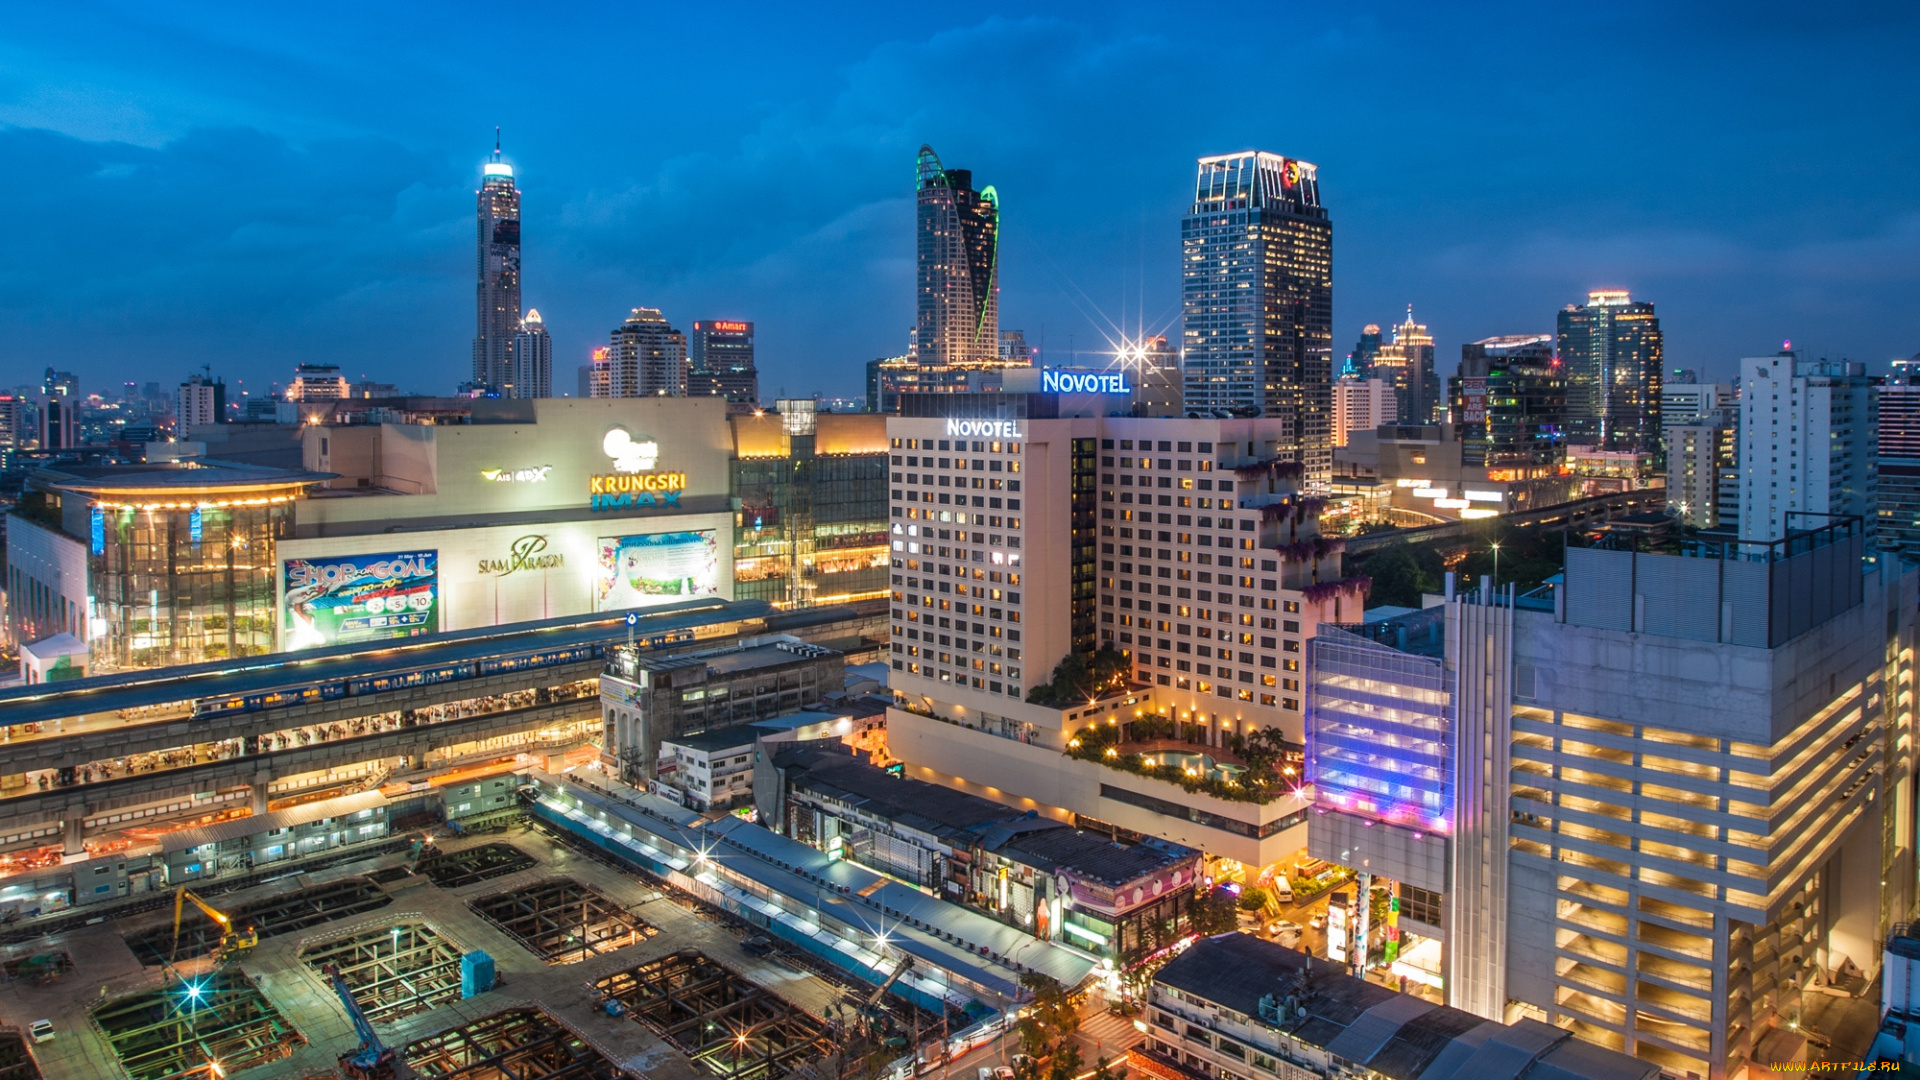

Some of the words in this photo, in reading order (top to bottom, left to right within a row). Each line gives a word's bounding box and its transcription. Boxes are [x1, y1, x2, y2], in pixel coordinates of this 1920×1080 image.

[1042, 371, 1131, 393] NOVOTEL
[1464, 381, 1486, 390] ZEN
[1464, 411, 1486, 422] BACK
[947, 418, 1022, 438] NOVOTEL
[496, 473, 511, 482] AIS
[590, 473, 686, 493] KRUNGSRI
[590, 490, 683, 513] IMAX
[289, 564, 356, 587] SHOP
[373, 559, 433, 579] GOAL
[478, 557, 510, 574] SIAM
